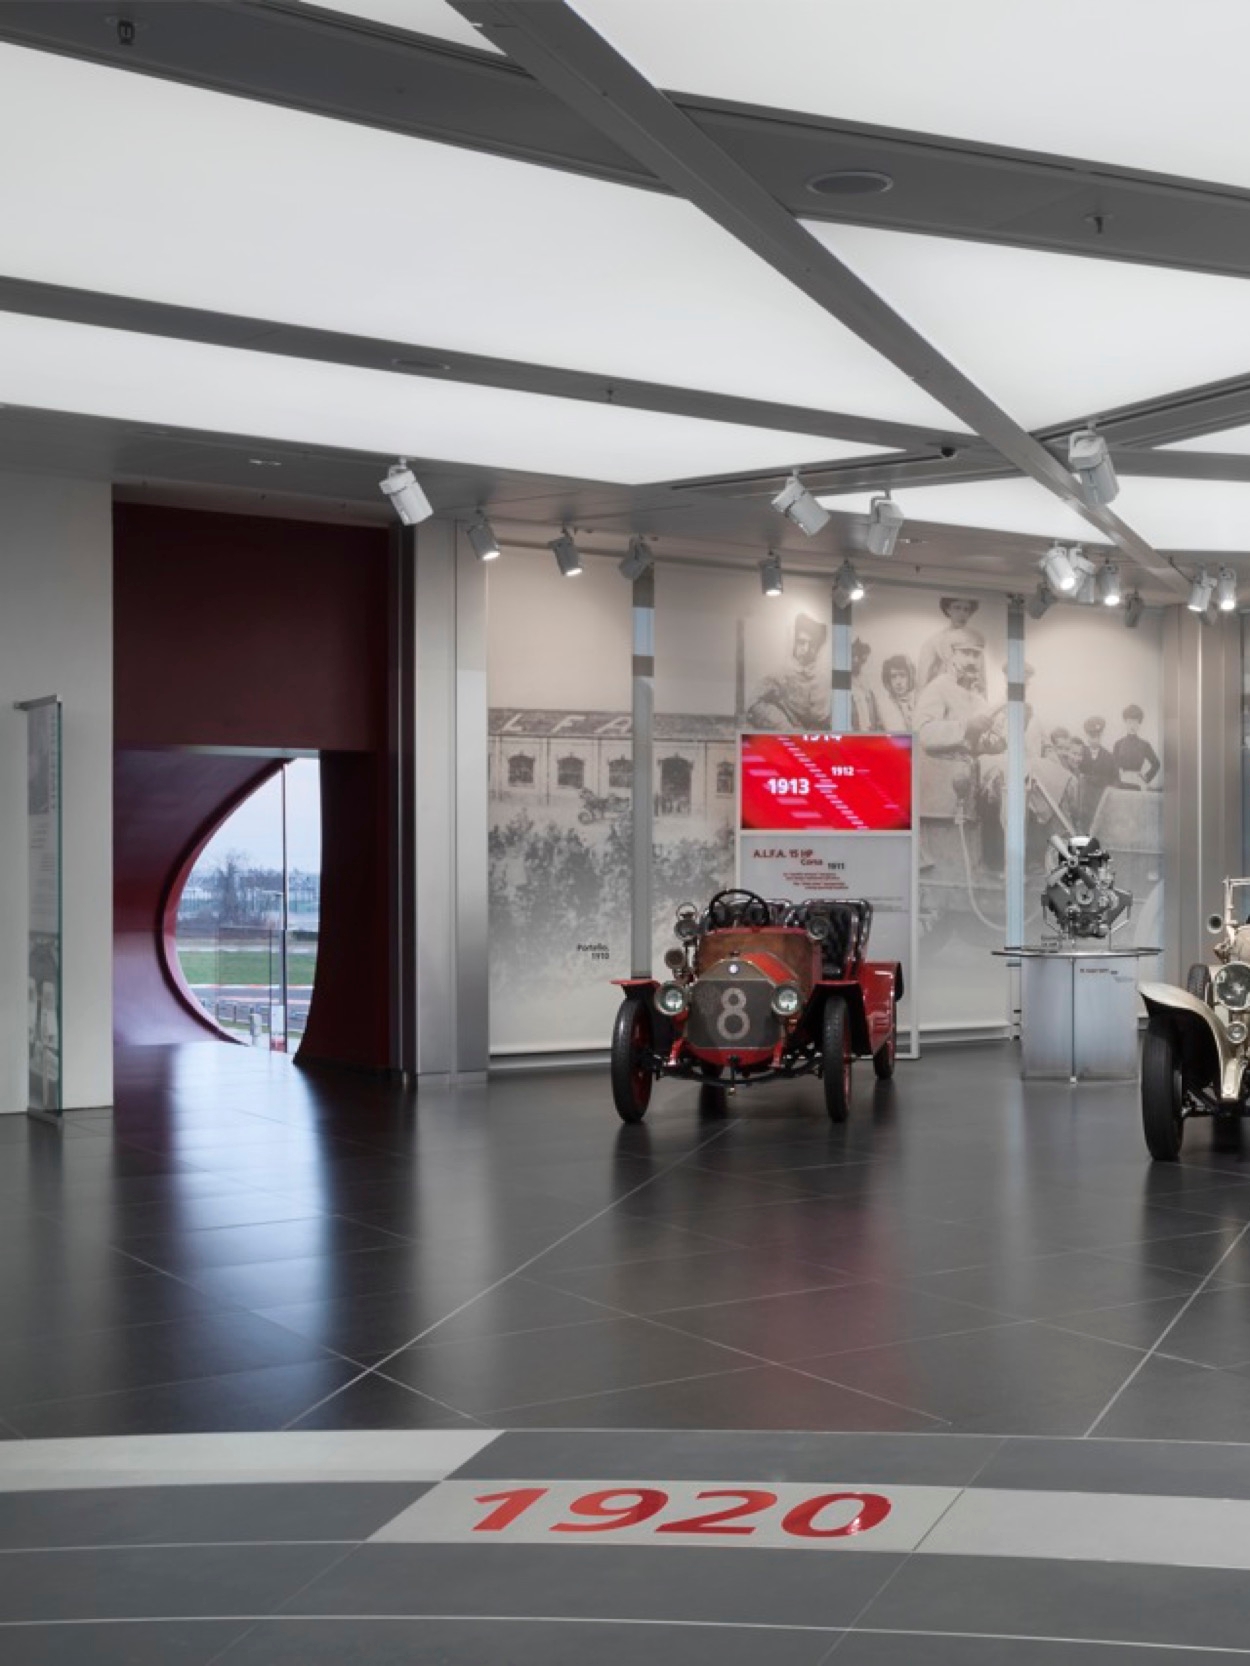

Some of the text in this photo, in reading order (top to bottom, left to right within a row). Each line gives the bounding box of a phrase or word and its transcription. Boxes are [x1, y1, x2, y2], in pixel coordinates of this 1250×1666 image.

[768, 778, 810, 795] 1913
[831, 766, 855, 777] 1912
[717, 987, 750, 1040] 8
[471, 1487, 892, 1537] 1920
